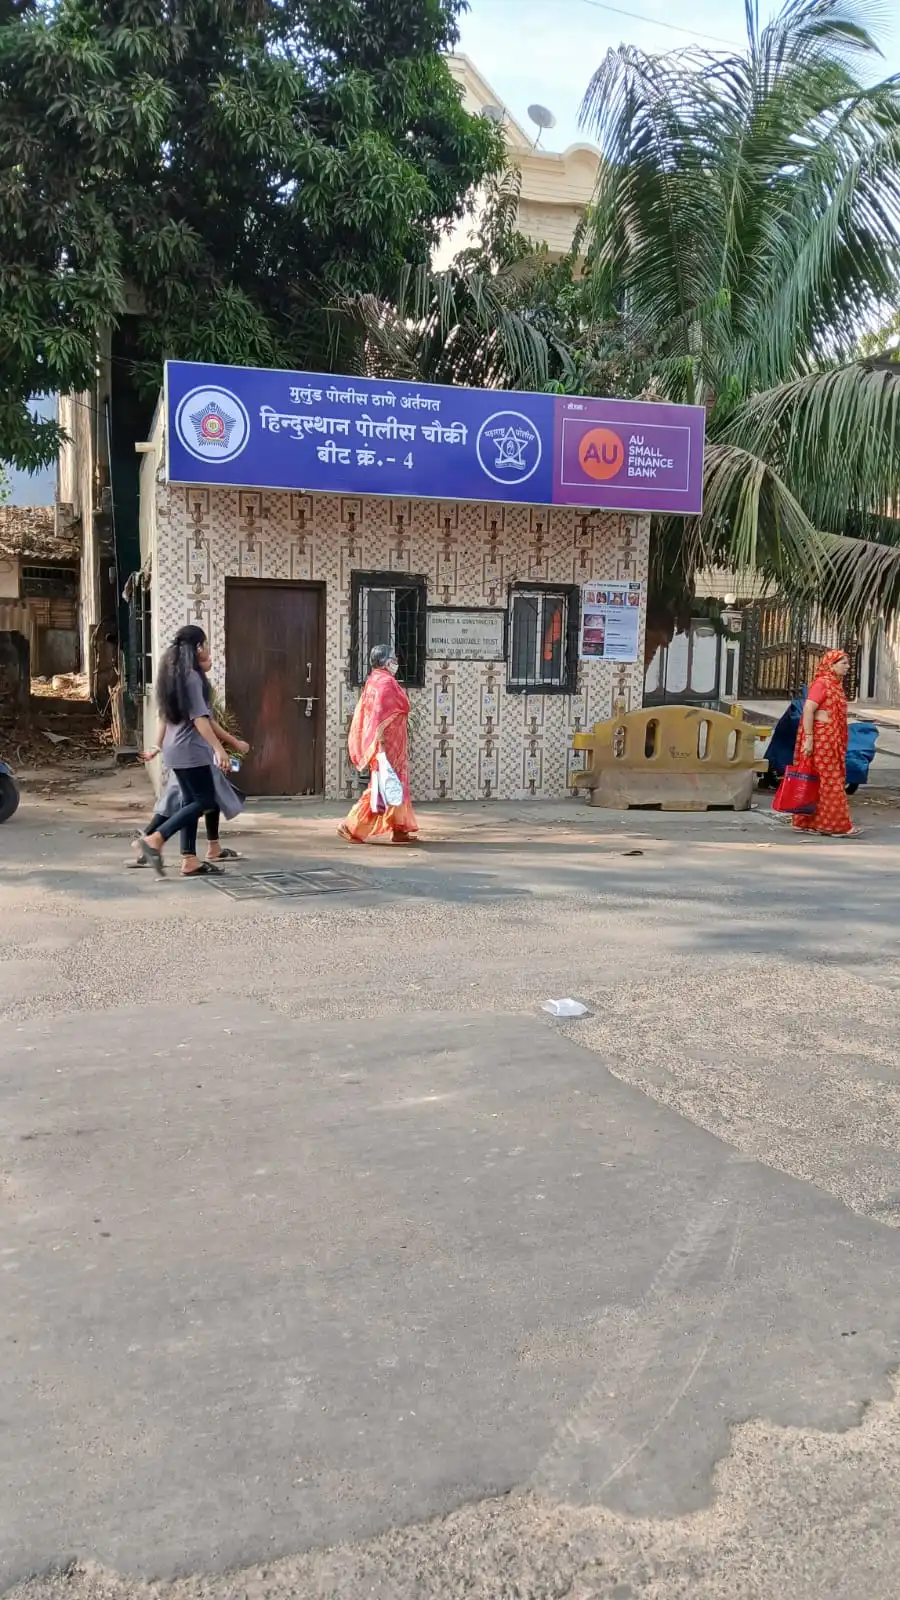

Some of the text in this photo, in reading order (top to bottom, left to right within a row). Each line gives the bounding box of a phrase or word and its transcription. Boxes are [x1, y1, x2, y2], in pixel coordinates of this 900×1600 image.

[289, 384, 322, 405] मुलुंड
[325, 386, 368, 406] पोलीस
[371, 390, 396, 408] ठाणे
[259, 405, 351, 440] हिन्दुस्थान
[355, 414, 417, 442] पोलीस
[421, 420, 468, 446] चौकी
[628, 434, 645, 446] AU
[316, 440, 351, 466] बीट
[403, 451, 414, 470] 4
[583, 441, 619, 466] AU
[628, 444, 663, 457] SMALL
[627, 456, 674, 469] FINANCE
[627, 466, 657, 478] BANK
